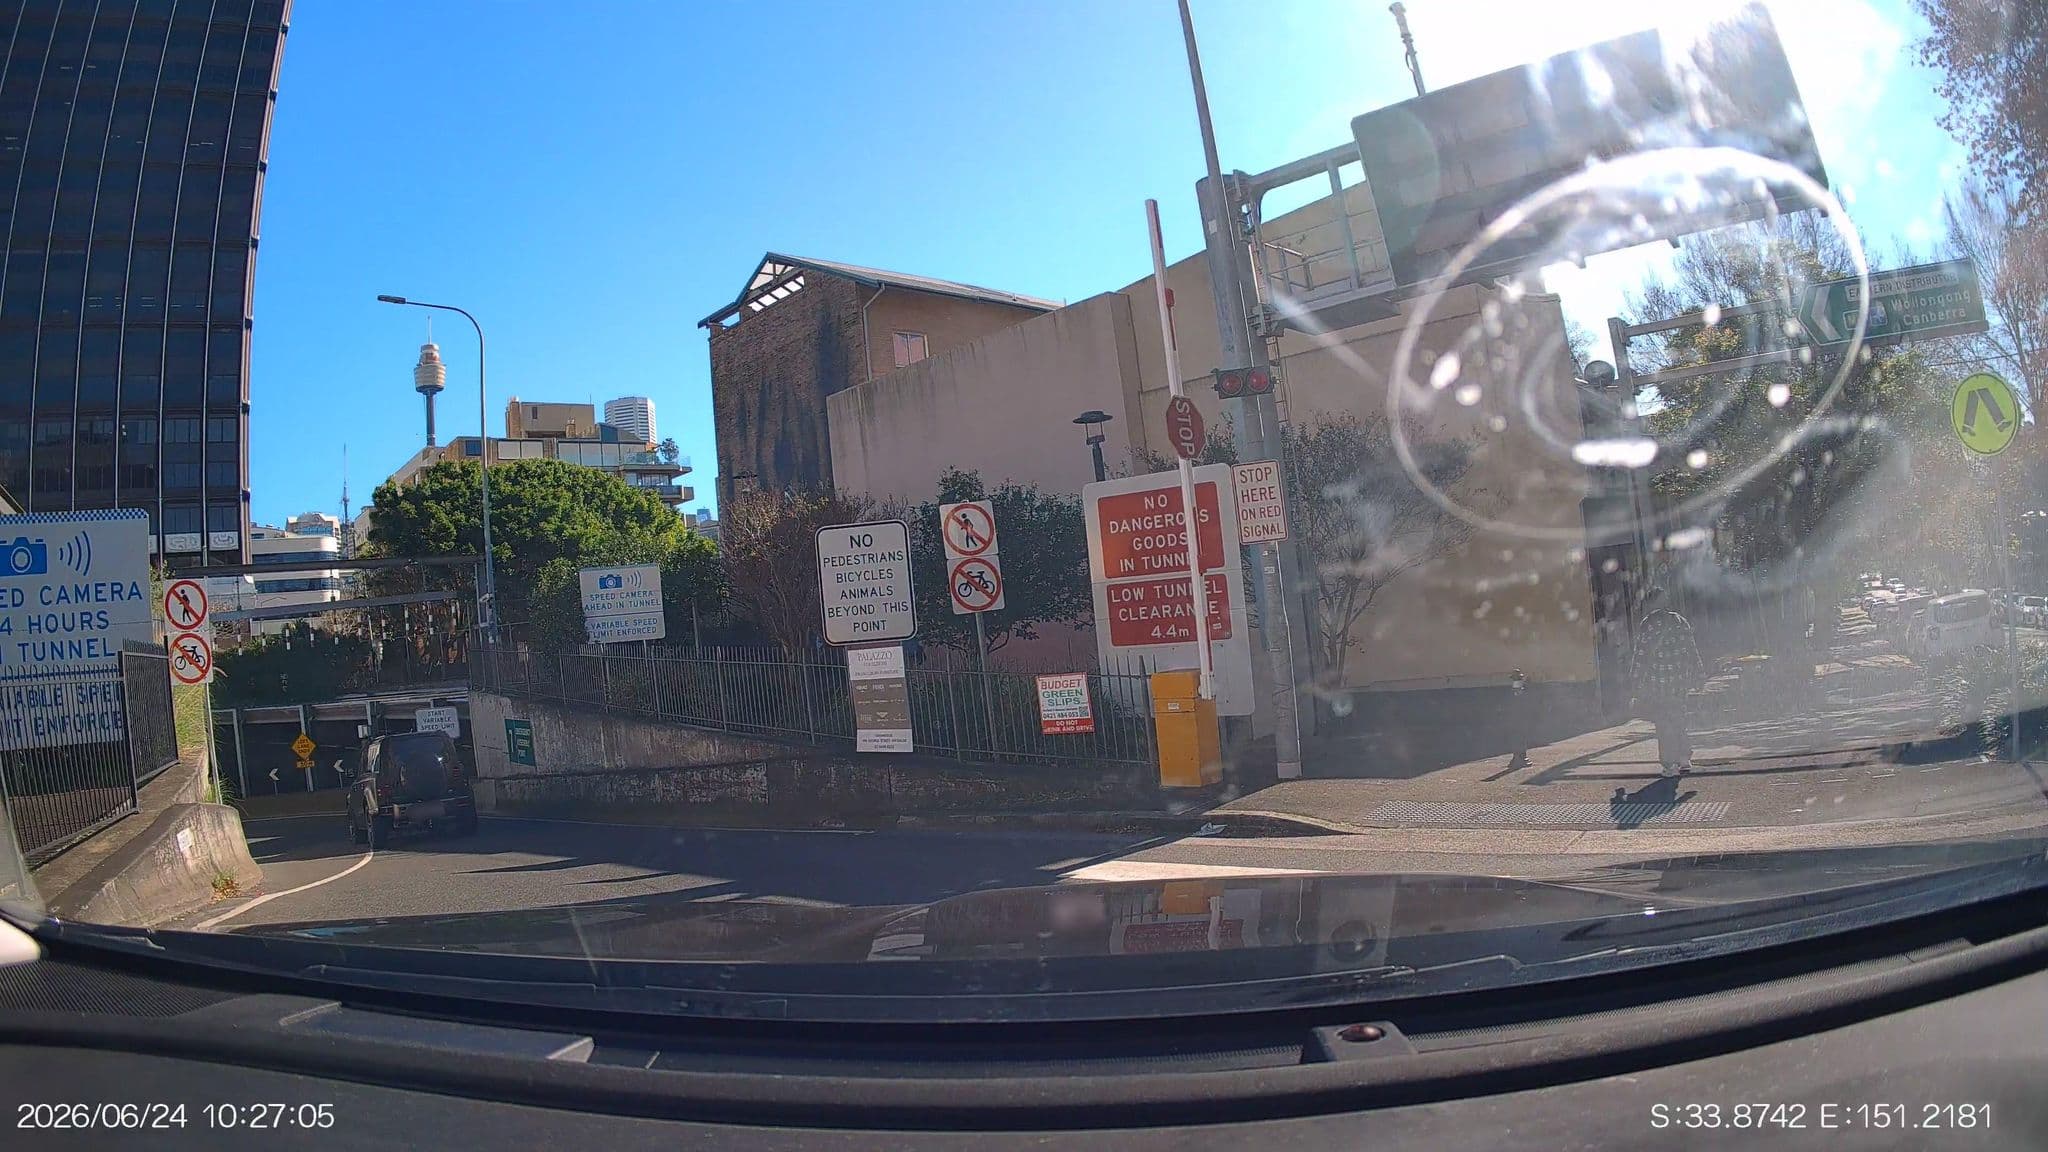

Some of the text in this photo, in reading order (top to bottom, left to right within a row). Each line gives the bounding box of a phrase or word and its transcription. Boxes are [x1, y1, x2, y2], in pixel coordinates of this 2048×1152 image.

[1891, 289, 1970, 312] Wollongong
[1903, 308, 1966, 325] Canberra
[1176, 400, 1195, 455] STOP
[1240, 467, 1272, 483] STOP
[1144, 494, 1168, 510] NO
[1242, 486, 1276, 504] HERE
[1242, 506, 1280, 520] ON RED
[1110, 509, 1208, 534] DANGEROS
[1244, 522, 1284, 537] SIGNAL
[850, 534, 873, 548] NO
[1133, 532, 1188, 550] GOODS
[824, 551, 904, 568] PEDESTRIANS
[1120, 558, 1134, 572] IN
[836, 569, 894, 584] BICYCLES
[40, 581, 142, 606] CAMERA
[590, 590, 653, 601] SPEED CAMERA
[840, 586, 894, 600] ANIMALS
[1111, 580, 1222, 602] LOW TUNEL
[584, 602, 612, 612] AHEAD
[629, 599, 661, 608] TUNNEL
[828, 602, 908, 618] BEYOND THIS
[1118, 600, 1219, 621] CLEARANE
[28, 610, 110, 634] HOURS
[591, 618, 658, 630] VARIABLE SPEED
[853, 620, 886, 632] POINT
[617, 627, 656, 636] ENFORCED
[17, 638, 116, 662] TUNNEL
[1041, 680, 1080, 689] BUDGET
[1043, 688, 1082, 698] GREEN
[1048, 697, 1080, 706] SLIPS
